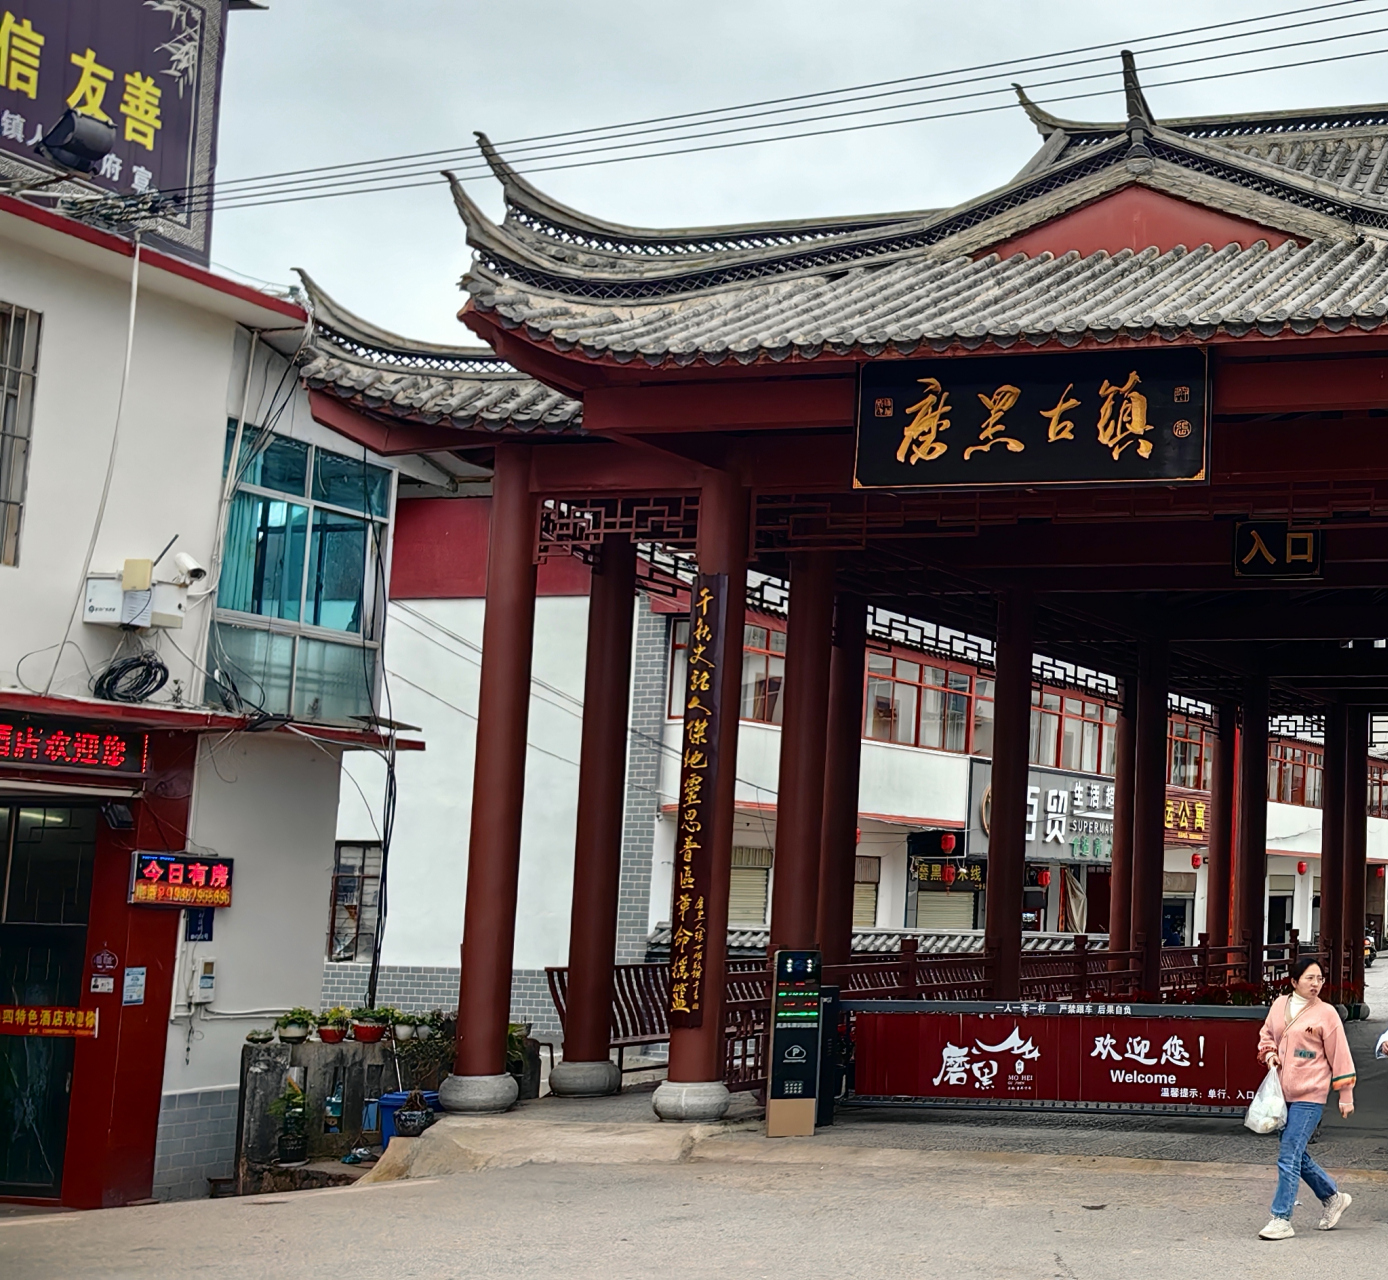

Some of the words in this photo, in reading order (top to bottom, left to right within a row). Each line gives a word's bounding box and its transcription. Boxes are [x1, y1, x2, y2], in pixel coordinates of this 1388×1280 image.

[66, 48, 162, 151] 友善
[1242, 530, 1313, 564] 入口
[142, 860, 229, 888] 今日有房
[918, 863, 981, 881] 磨黑米线
[995, 1003, 1046, 1015] 一人一车一杆
[1058, 1004, 1093, 1015] 严禁跟车
[1097, 1005, 1132, 1015] 后果自负
[1110, 1069, 1177, 1085] Welcome
